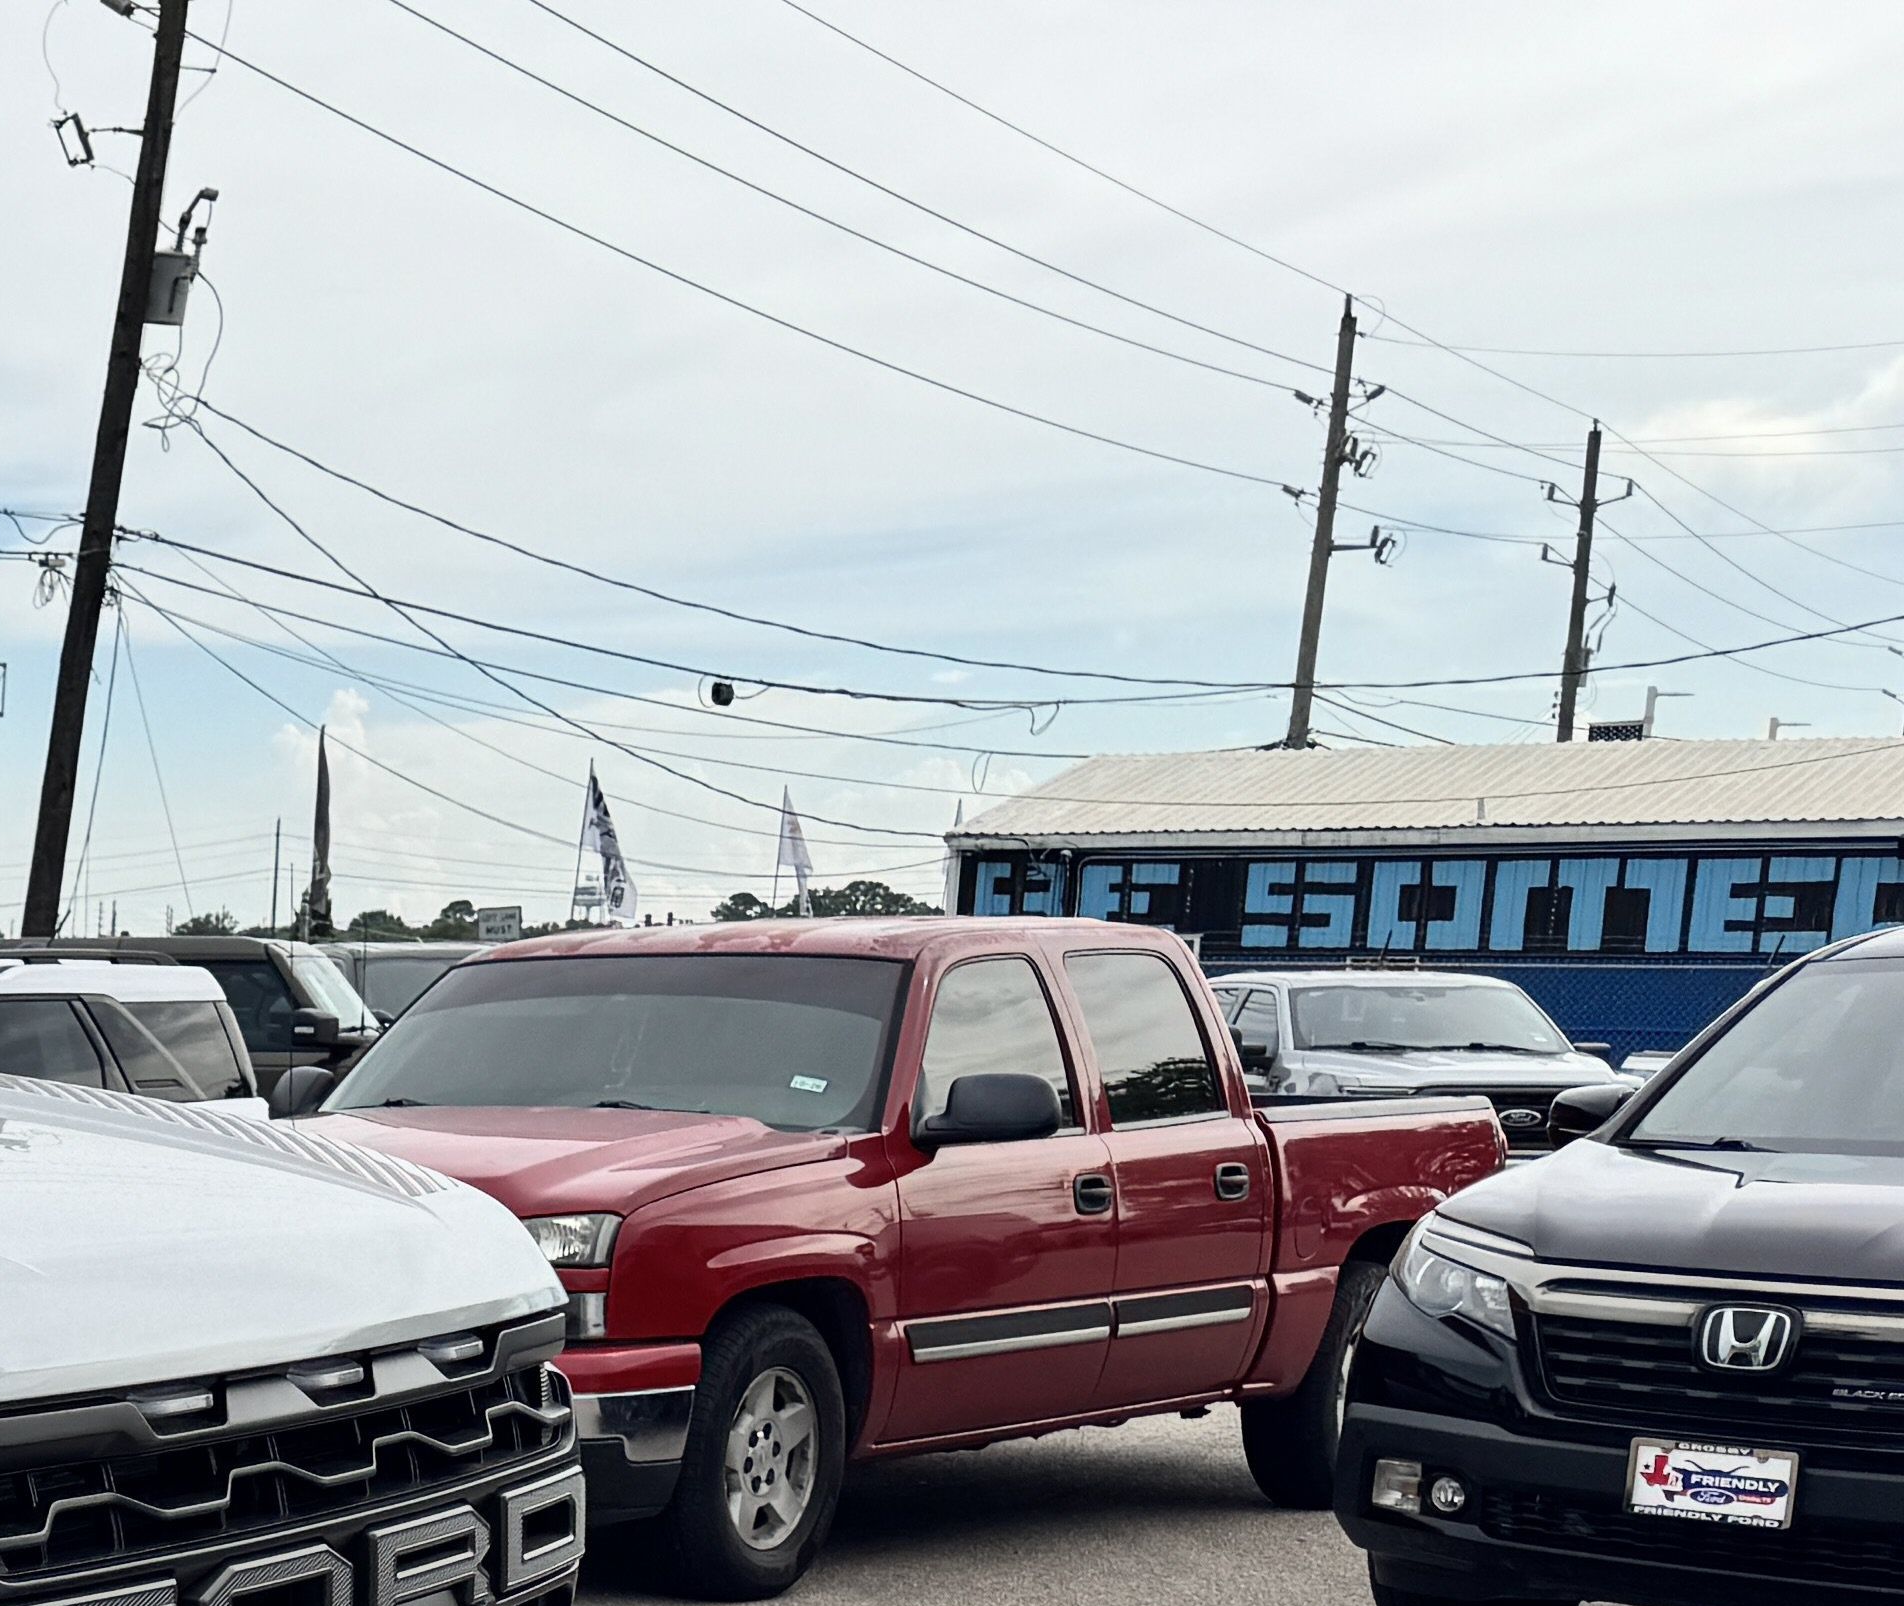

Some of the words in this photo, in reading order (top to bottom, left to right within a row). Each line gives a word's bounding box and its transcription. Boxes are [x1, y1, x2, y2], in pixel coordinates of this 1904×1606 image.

[1690, 1474, 1780, 1493] FRIENDLY
[1696, 1490, 1726, 1504] Ford
[1633, 1505, 1724, 1522] FRIENDLY
[1727, 1515, 1780, 1529] FORD
